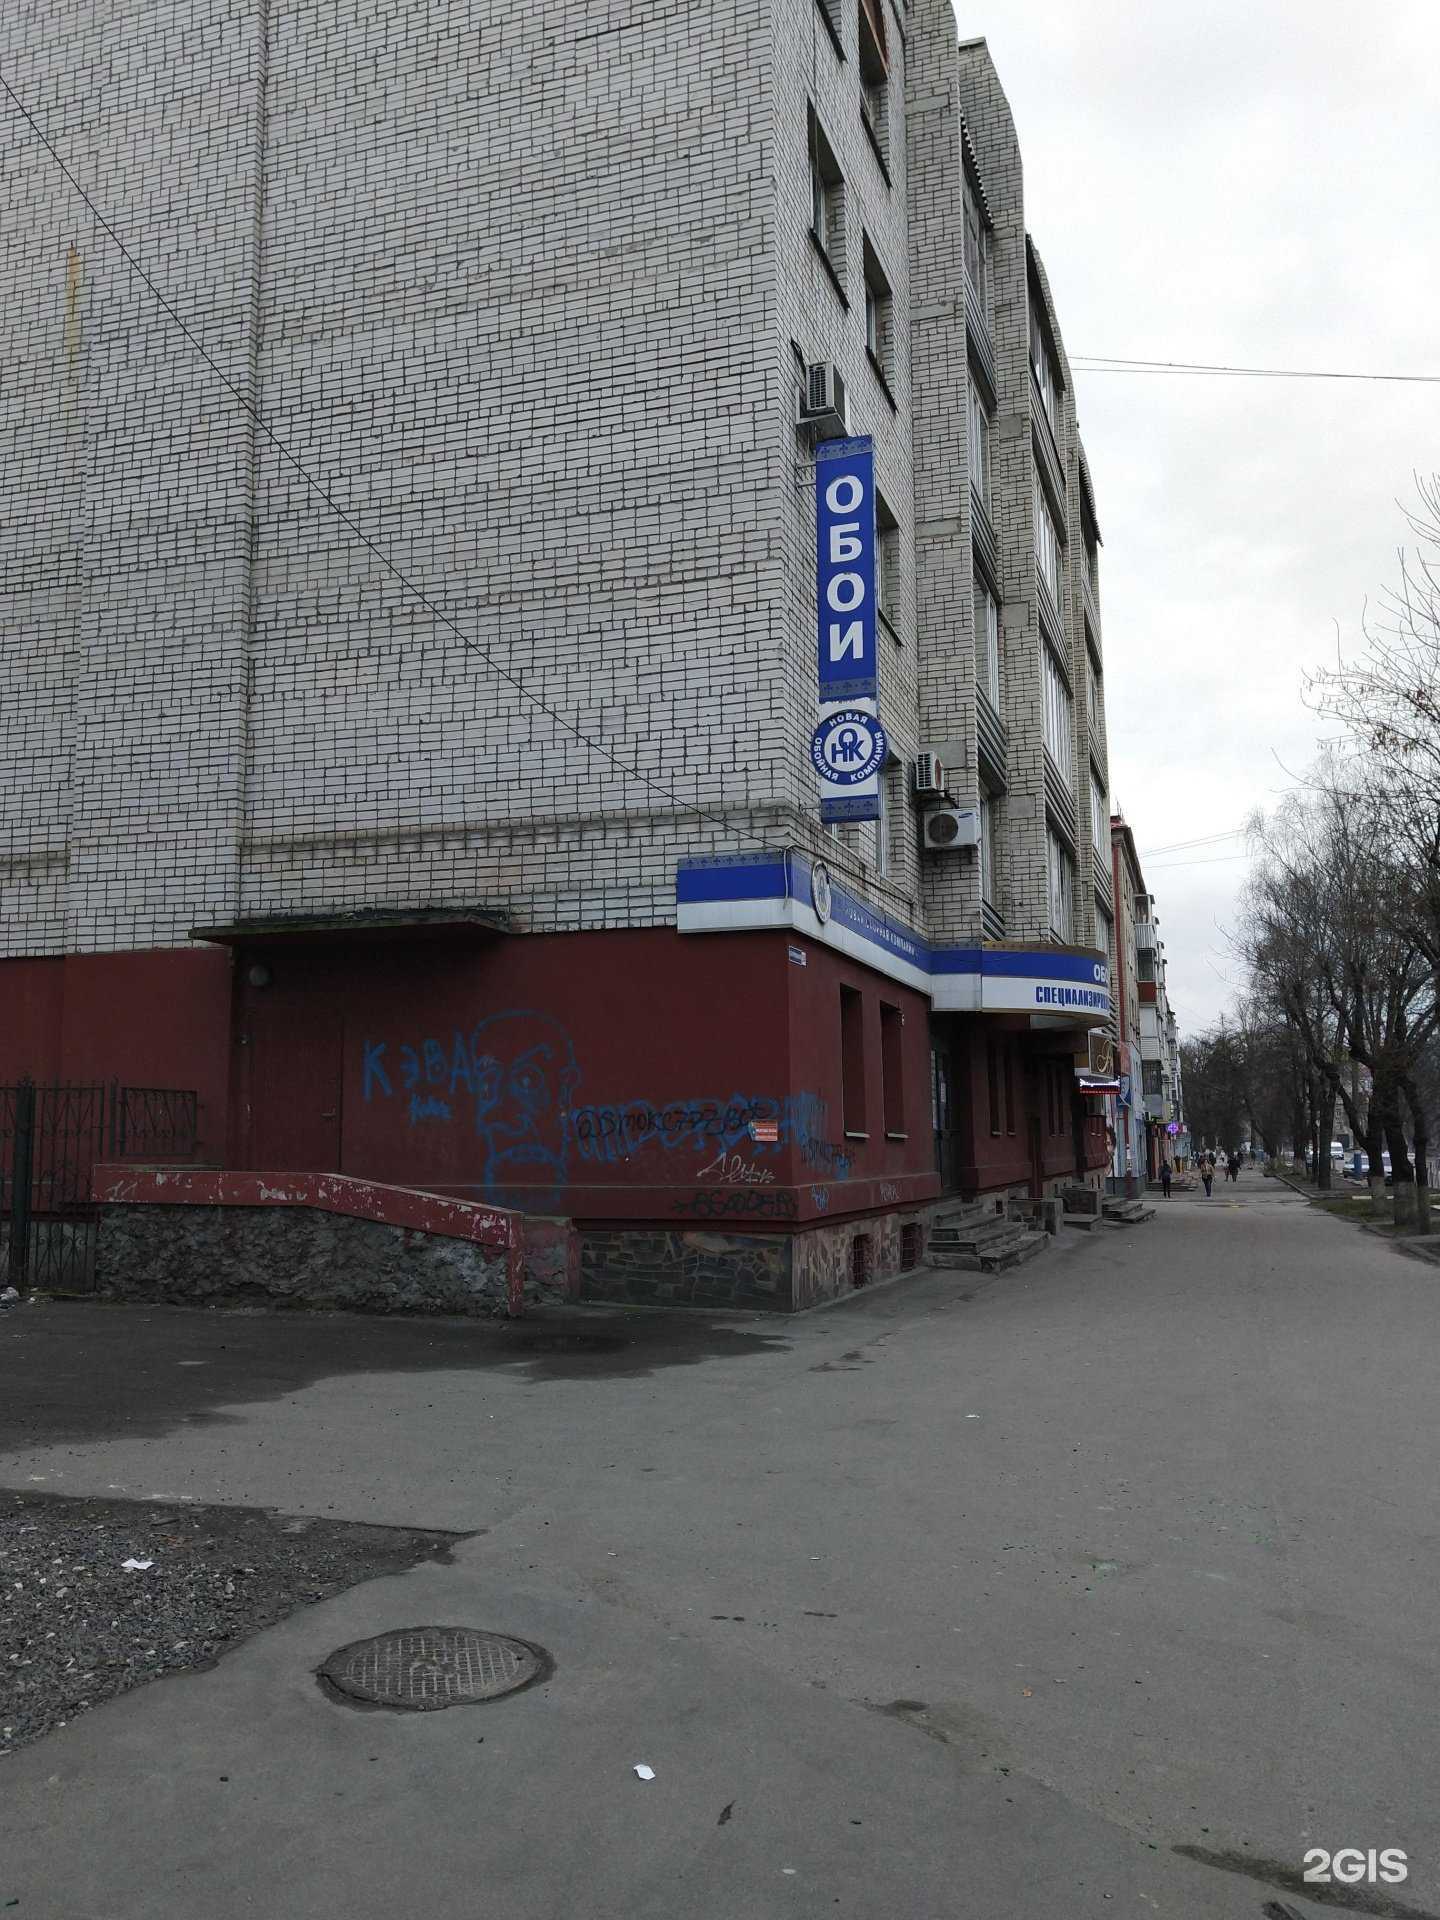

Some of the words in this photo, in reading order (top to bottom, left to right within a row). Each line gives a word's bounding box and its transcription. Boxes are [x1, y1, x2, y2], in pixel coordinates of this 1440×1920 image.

[825, 474, 865, 662] ОБОИ
[828, 712, 868, 727] НОВАЯ
[813, 737, 839, 781] ОБОЙНАЯ
[850, 731, 884, 782] КОМПАНИЯ
